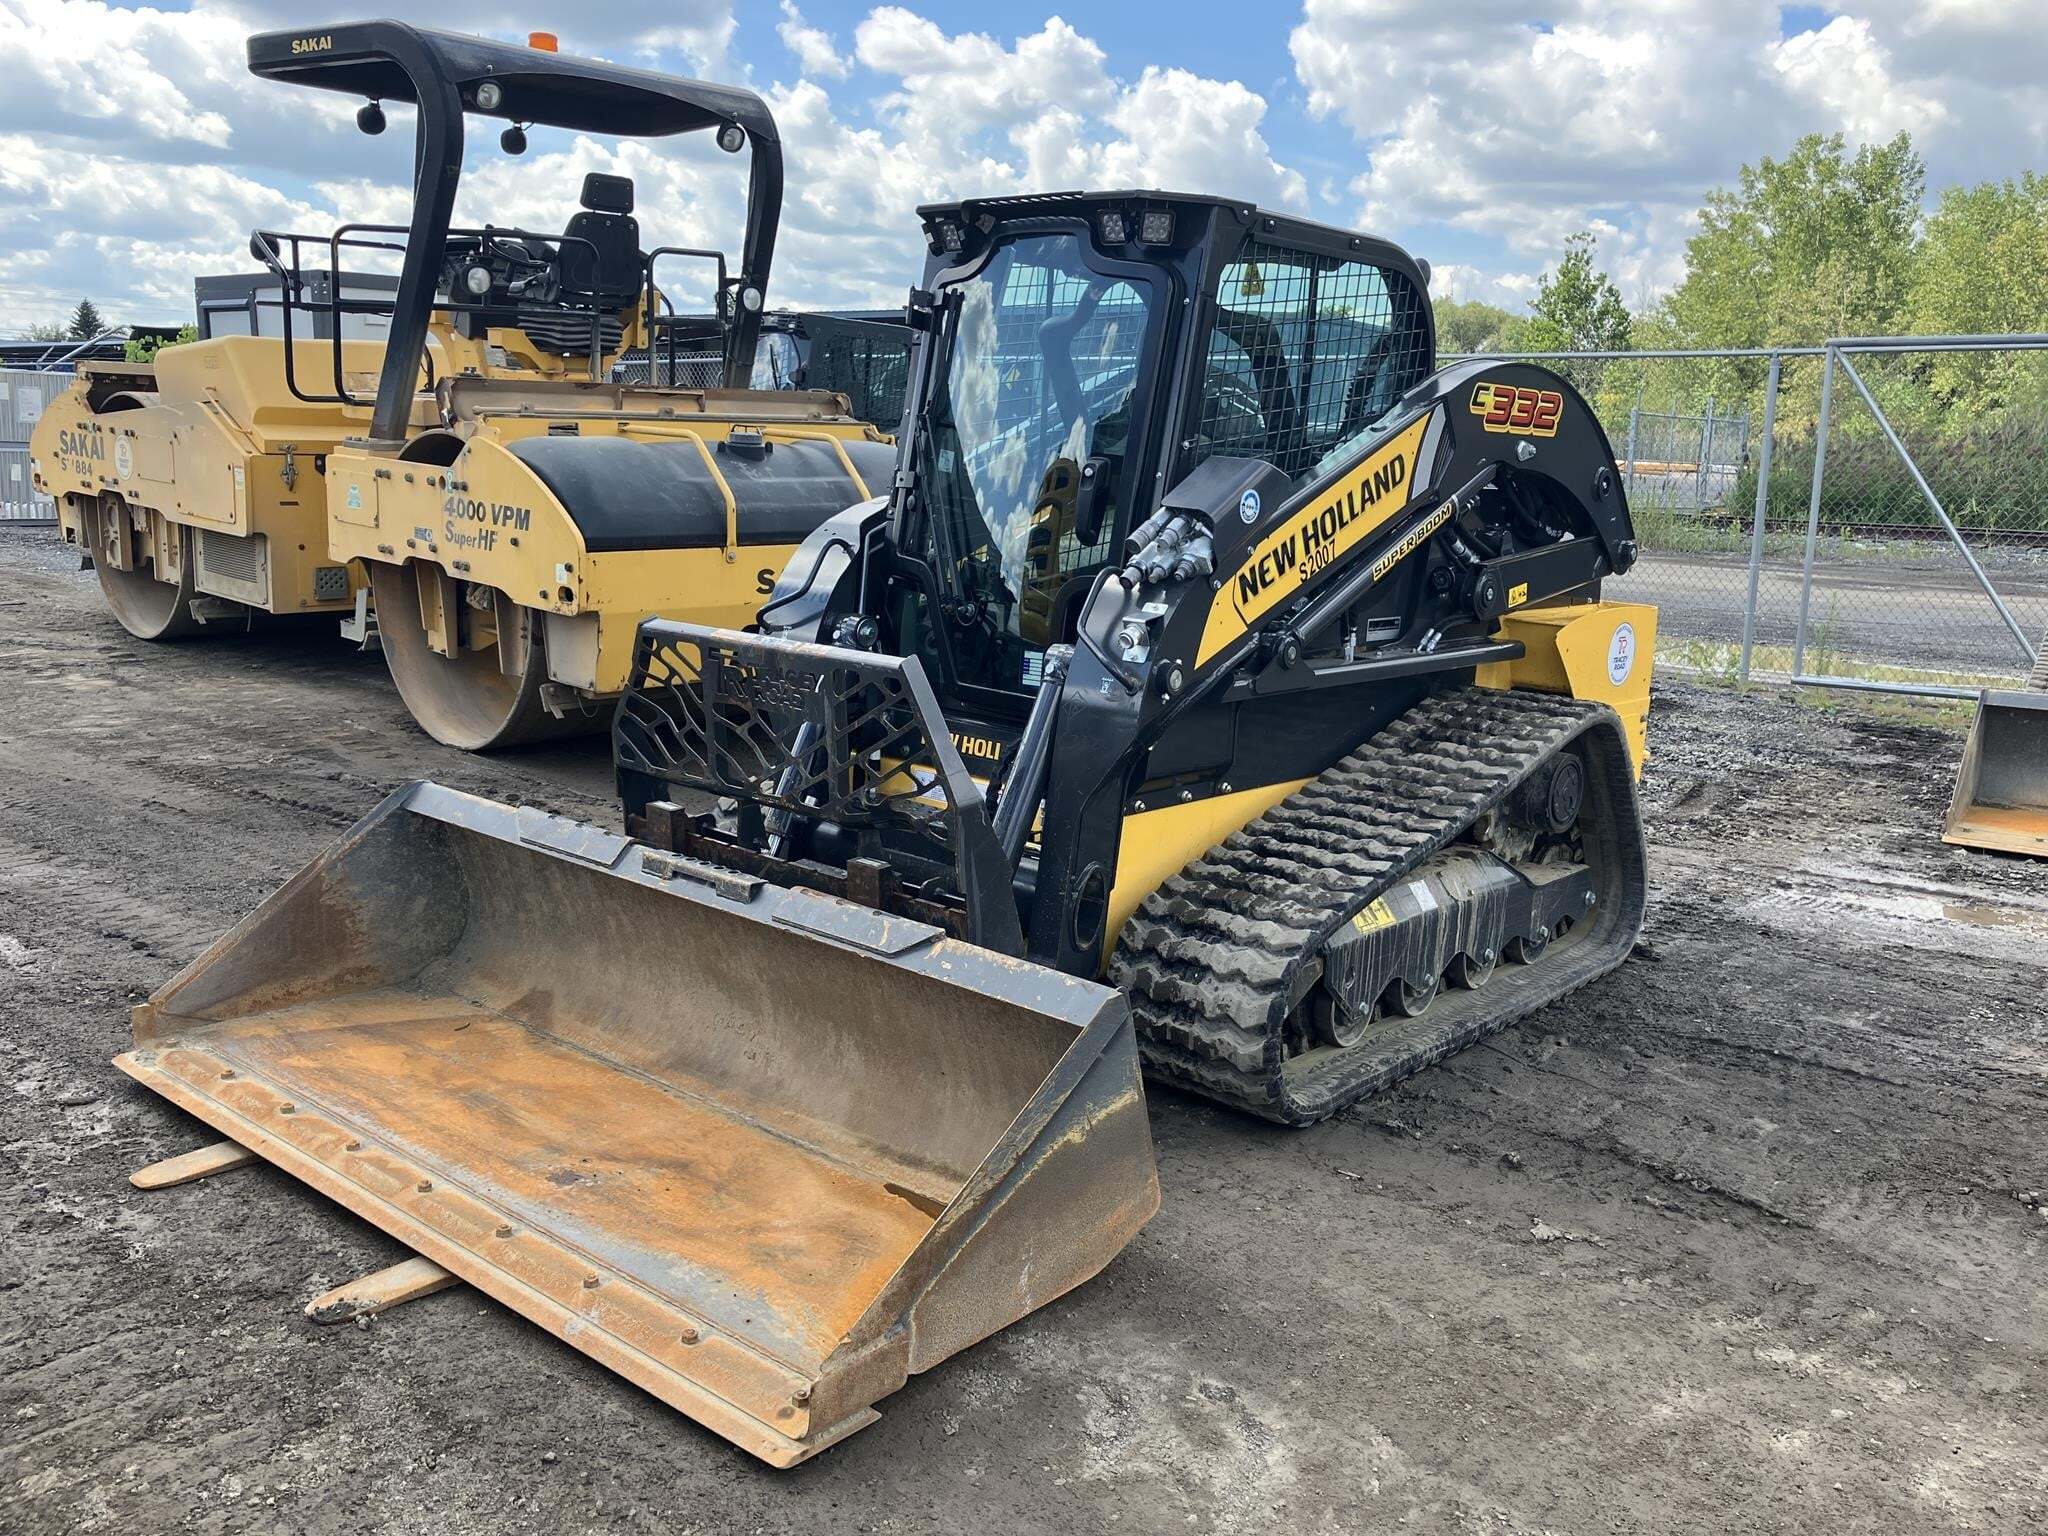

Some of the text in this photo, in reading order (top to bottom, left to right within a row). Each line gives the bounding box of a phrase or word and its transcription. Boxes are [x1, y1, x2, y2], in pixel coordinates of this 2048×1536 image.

[291, 36, 332, 54] SAKAI
[1469, 382, 1564, 437] C332
[60, 430, 105, 460] SAKAI
[61, 457, 92, 476] S884
[444, 496, 531, 531] 4000 VPM
[1238, 453, 1406, 605] NEW HOLLAND
[1300, 538, 1337, 584] S2007
[1373, 503, 1452, 579] SUPER BOOM
